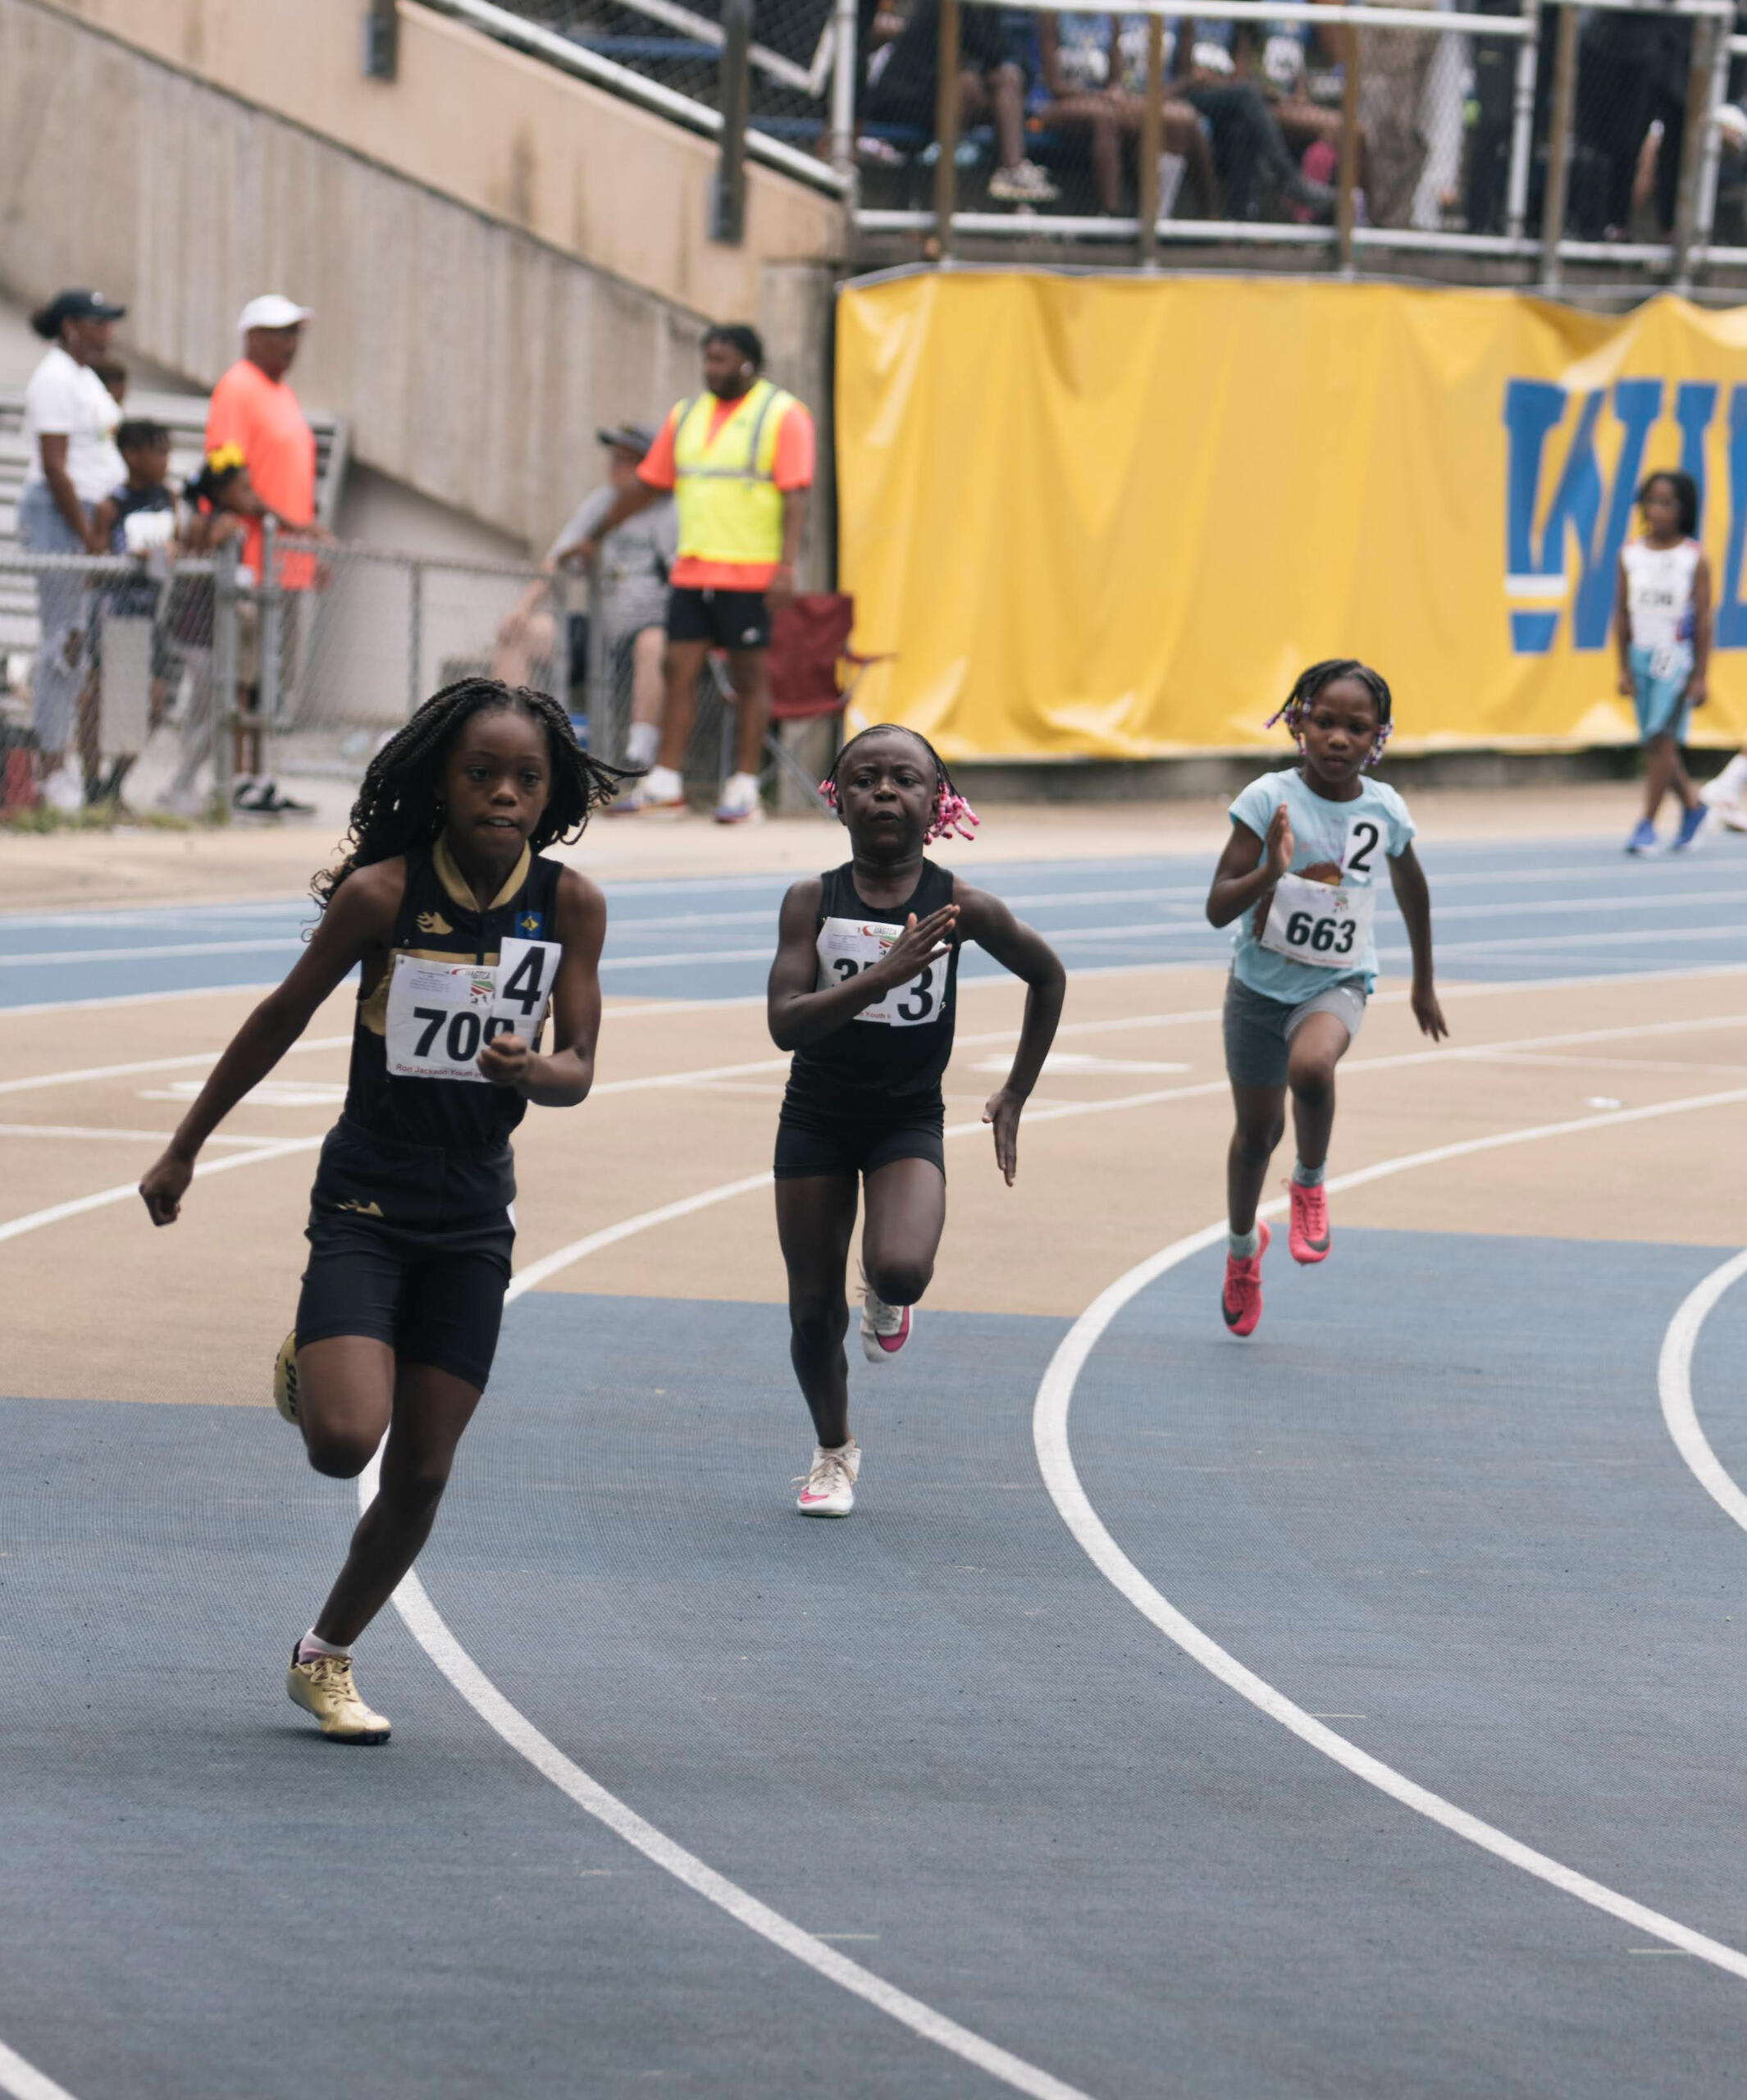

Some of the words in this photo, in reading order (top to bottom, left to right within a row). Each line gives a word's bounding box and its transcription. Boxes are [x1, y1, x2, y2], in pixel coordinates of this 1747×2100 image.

[1348, 822, 1379, 873] 2
[1285, 911, 1357, 953] 663
[502, 947, 545, 1016] 4
[896, 964, 933, 1021] 3
[395, 1063, 413, 1072] Ron
